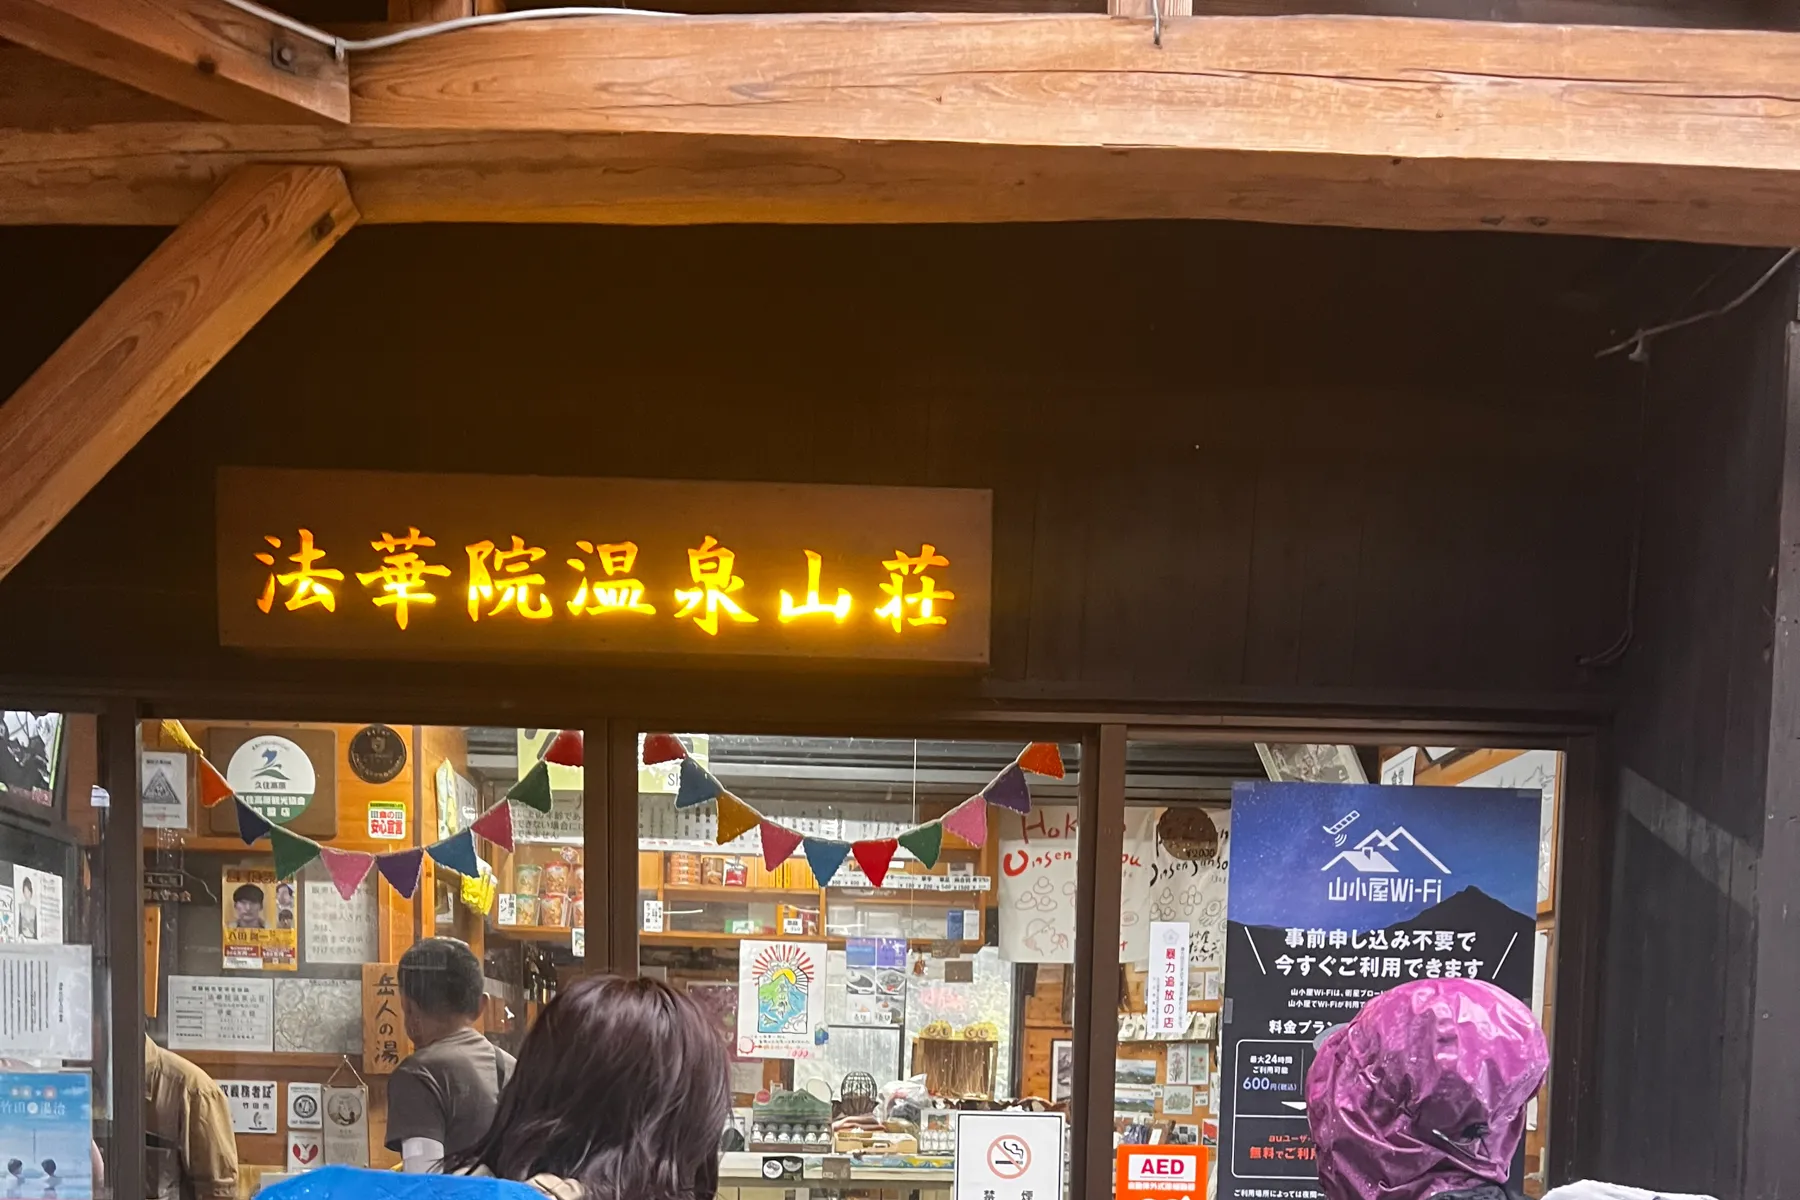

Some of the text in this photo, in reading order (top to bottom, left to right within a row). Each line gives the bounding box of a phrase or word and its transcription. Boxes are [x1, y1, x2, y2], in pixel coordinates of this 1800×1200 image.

[255, 527, 955, 635] 法華院温泉山荘
[1328, 876, 1442, 904] 山小屋Wi-Fi
[1284, 928, 1478, 951] 事前申し込み不要で
[1274, 954, 1484, 979] 今すぐご利用できます
[1163, 948, 1176, 1029] 暴力追放の店
[372, 972, 399, 1065] 岳人の湯
[1269, 1020, 1333, 1034] 料金プラ
[1252, 1066, 1289, 1075] ご利用可能
[1268, 1135, 1311, 1143] auユーザ
[1141, 1159, 1185, 1175] AED
